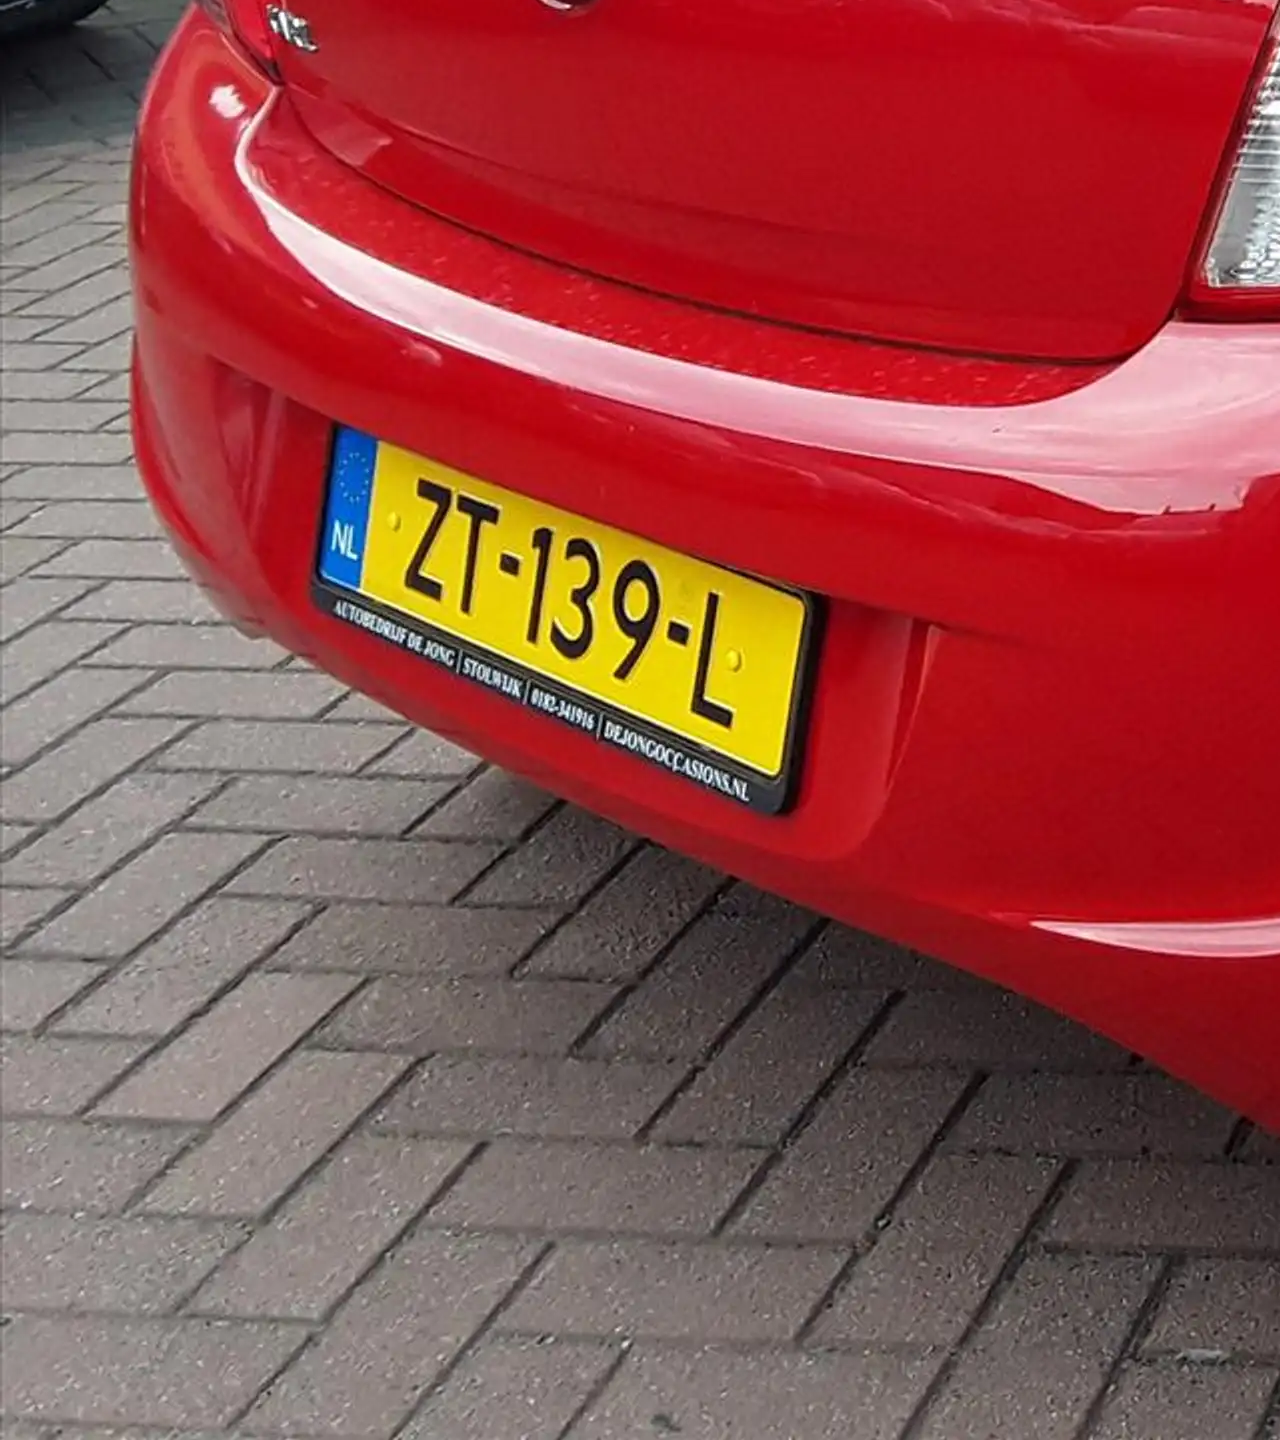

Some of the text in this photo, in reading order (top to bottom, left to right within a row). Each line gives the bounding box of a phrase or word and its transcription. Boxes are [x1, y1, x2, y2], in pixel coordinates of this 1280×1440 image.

[331, 519, 358, 560] NL
[404, 478, 733, 729] ZT-139-L
[333, 600, 750, 801] AUTOBEDRIJF DE JONG STOLWIJK 0182-341916 DEJONGOCCASIONS.NL
